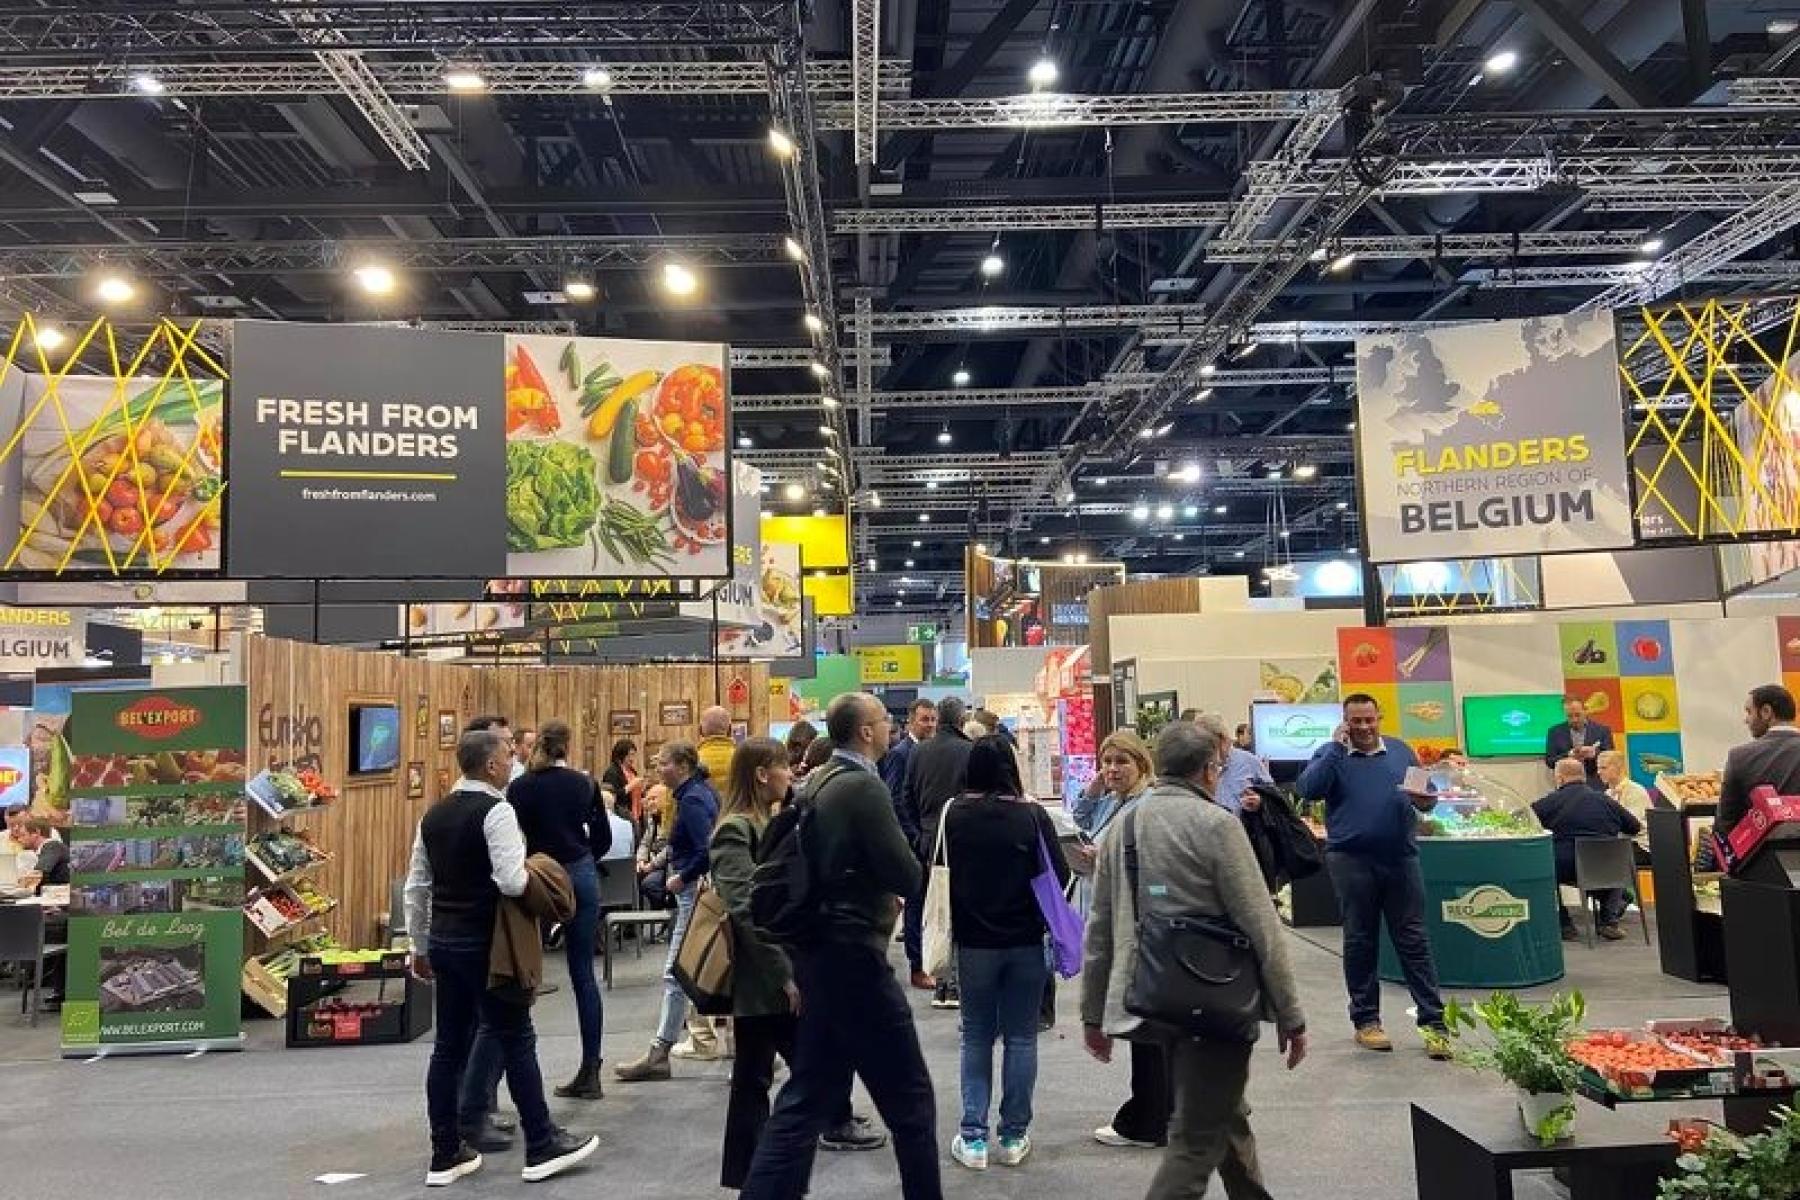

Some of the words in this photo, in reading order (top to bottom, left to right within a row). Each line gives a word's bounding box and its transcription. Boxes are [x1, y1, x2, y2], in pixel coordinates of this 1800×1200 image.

[256, 399, 370, 426] FRESH
[382, 403, 478, 430] FROM
[278, 428, 459, 459] FLANDERS
[1395, 433, 1591, 477] FLANDERS
[302, 487, 438, 502] freshfromflanders.com
[1397, 475, 1489, 497] NORTHERN
[1496, 470, 1562, 489] REGION
[1567, 466, 1593, 483] OF
[1401, 489, 1594, 534] BELGIUM
[120, 708, 197, 727] BEL'EXPORT
[100, 1021, 206, 1035] WW.BELEXPORT.COM
